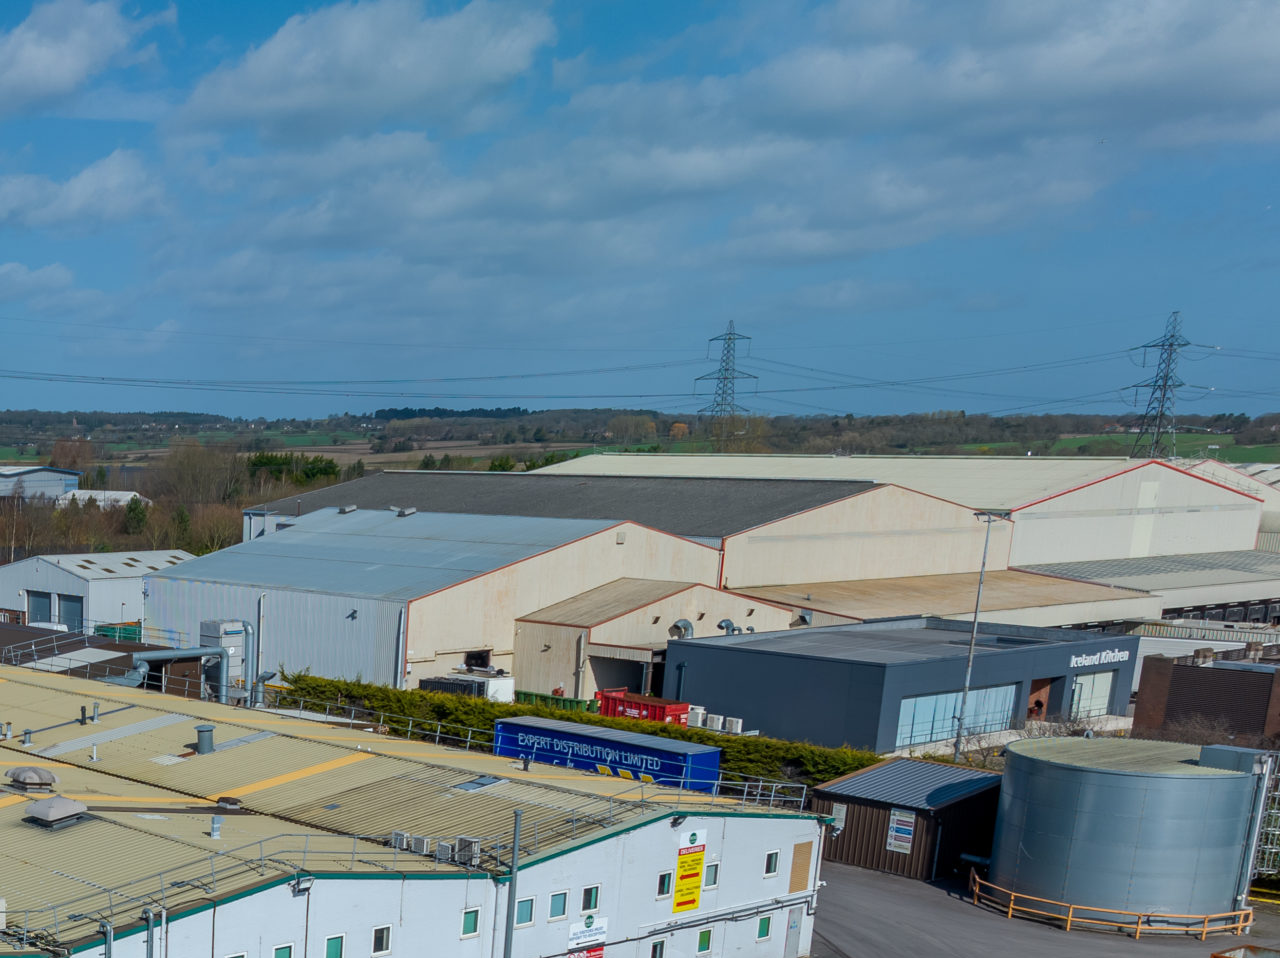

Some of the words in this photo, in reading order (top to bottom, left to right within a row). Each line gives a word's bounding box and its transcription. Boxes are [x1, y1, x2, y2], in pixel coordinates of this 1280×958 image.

[1069, 652, 1100, 668] Iceland
[1100, 648, 1130, 664] Kitchen
[518, 733, 551, 749] EXPERT
[554, 738, 619, 761] DISTRIBUTION
[622, 751, 661, 770] LIMITED
